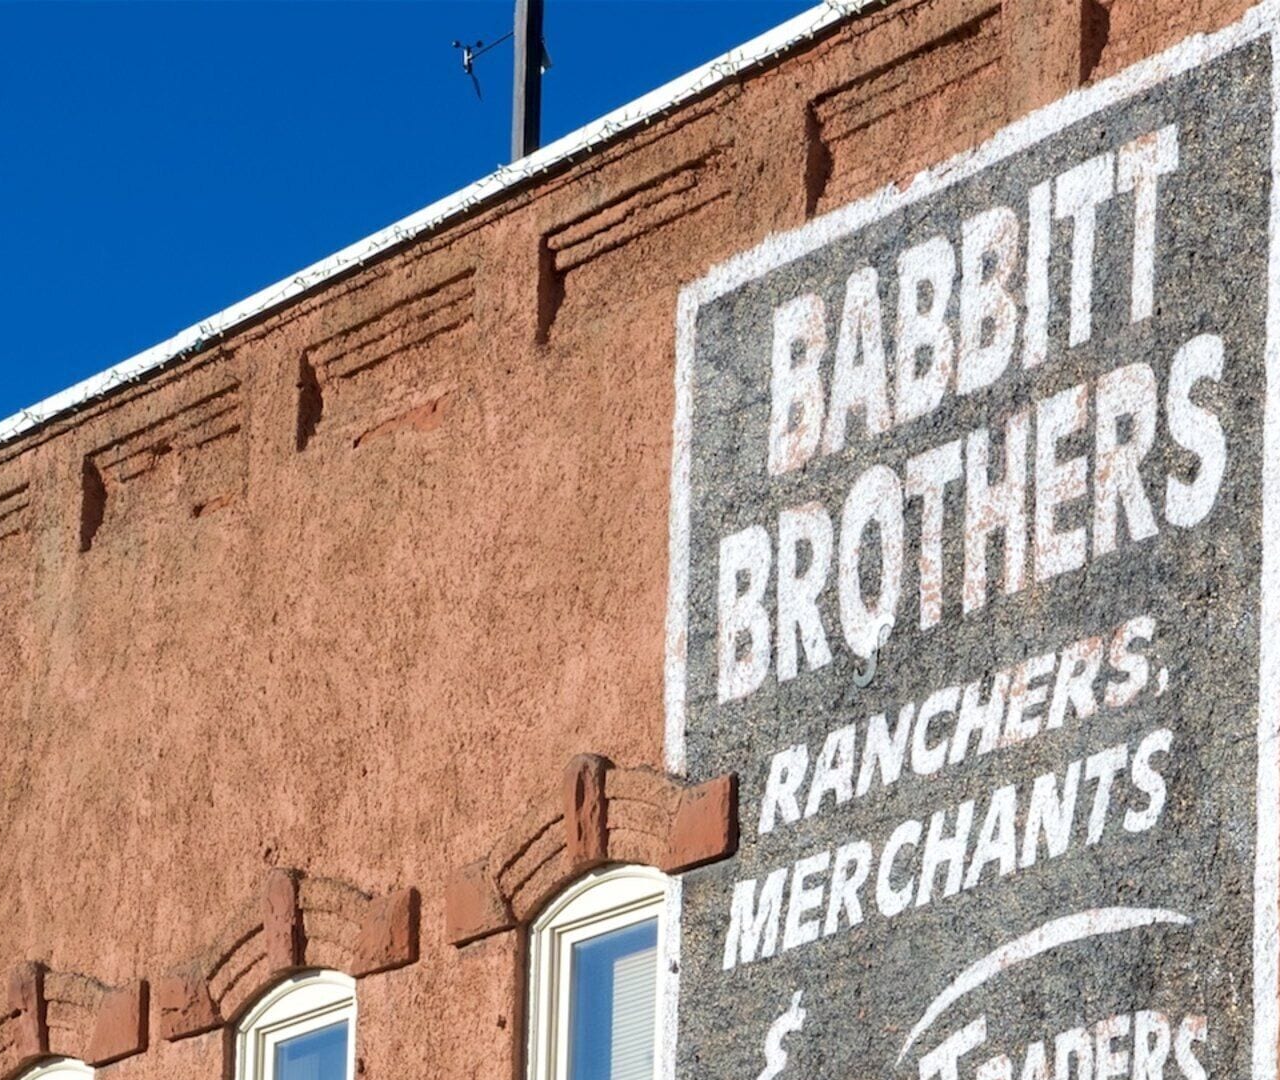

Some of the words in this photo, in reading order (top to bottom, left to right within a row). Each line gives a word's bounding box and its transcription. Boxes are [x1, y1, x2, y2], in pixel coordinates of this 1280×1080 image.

[767, 124, 1179, 477] BABBITT
[718, 332, 1228, 701] BROTHERS
[722, 728, 1175, 971] MERCHANTS
[757, 615, 1170, 835] RANCHERS,
